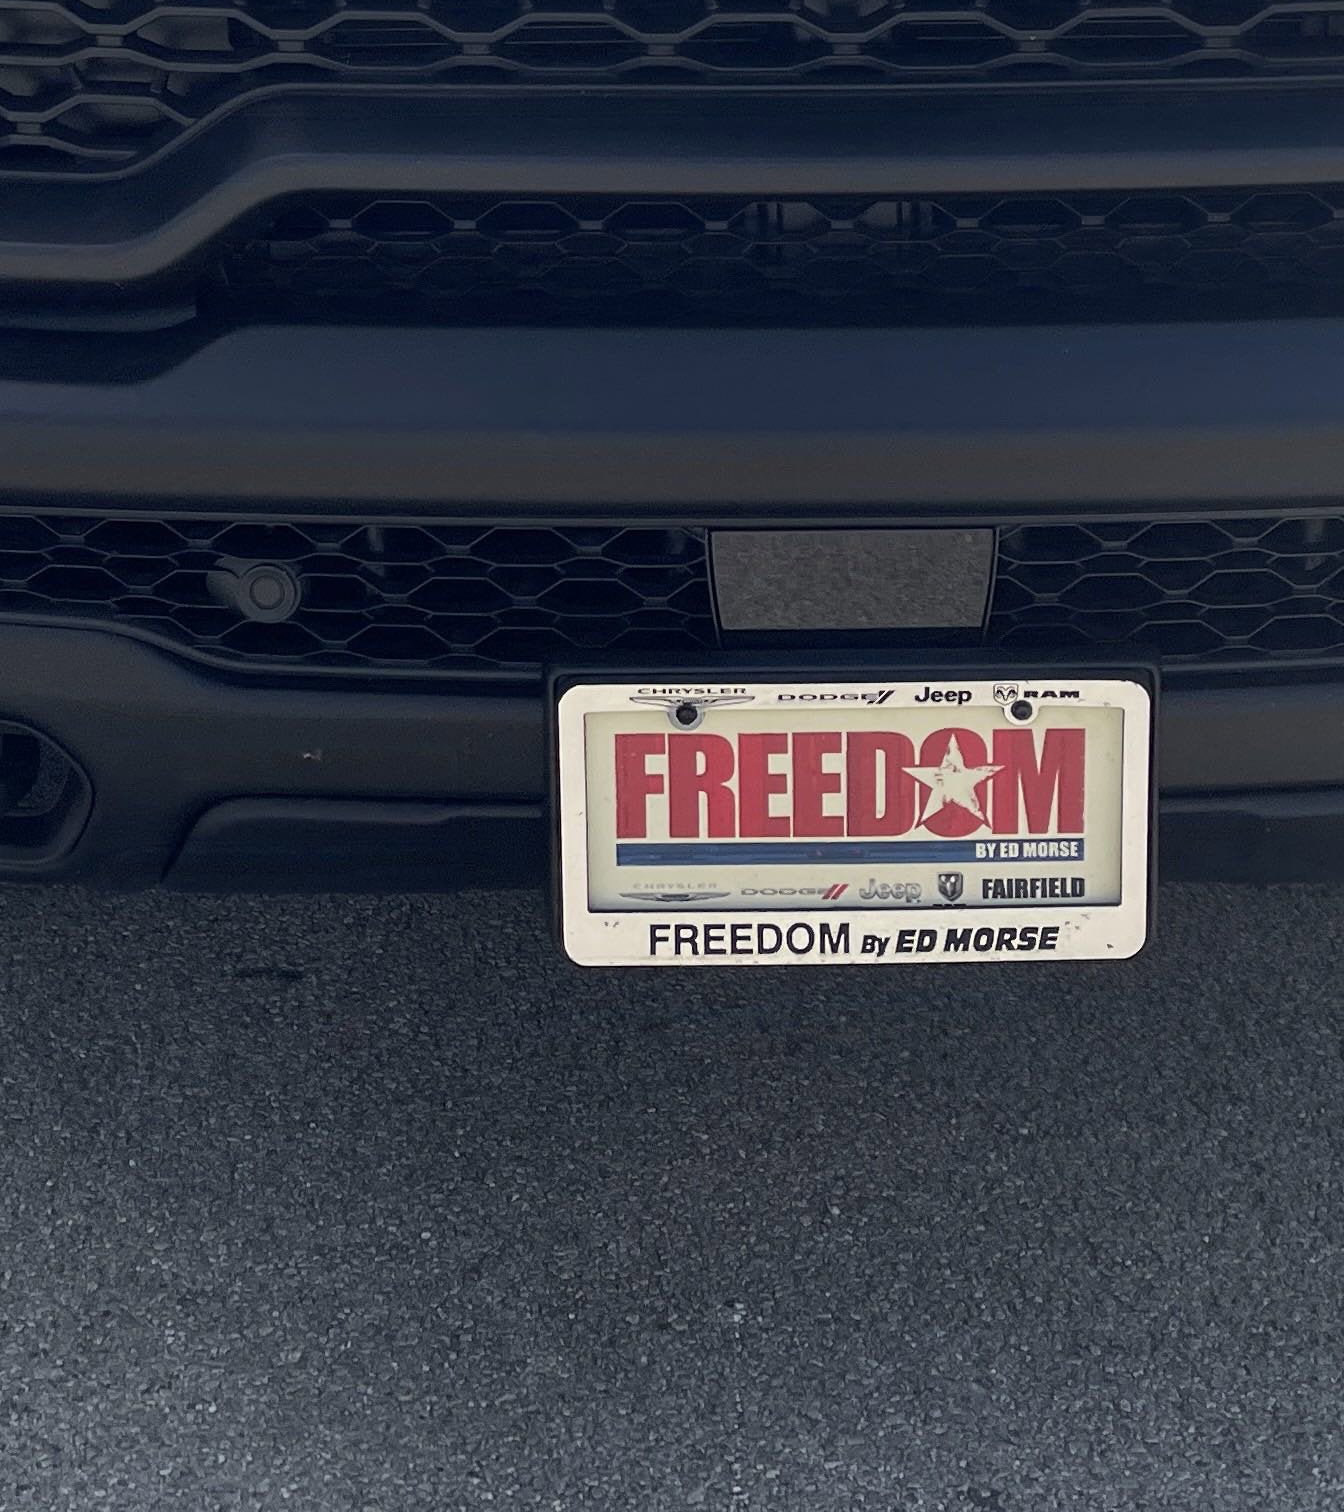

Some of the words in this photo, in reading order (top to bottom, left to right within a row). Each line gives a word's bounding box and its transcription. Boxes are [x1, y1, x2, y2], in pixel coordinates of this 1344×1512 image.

[637, 687, 747, 695] CHRYSLER
[914, 687, 973, 705] Jeep
[1023, 690, 1080, 699] RAM
[615, 728, 1086, 838] FREEDOM
[975, 842, 997, 859] BY
[1000, 842, 1019, 858] ED
[1022, 841, 1079, 858] MORSE
[633, 882, 718, 890] CHRYSLER
[859, 878, 922, 903] Jeep
[982, 877, 1086, 899] FAIRFIELD
[649, 922, 851, 956] FREEDOM
[895, 929, 938, 953] ED
[943, 926, 1060, 952] MORSE
